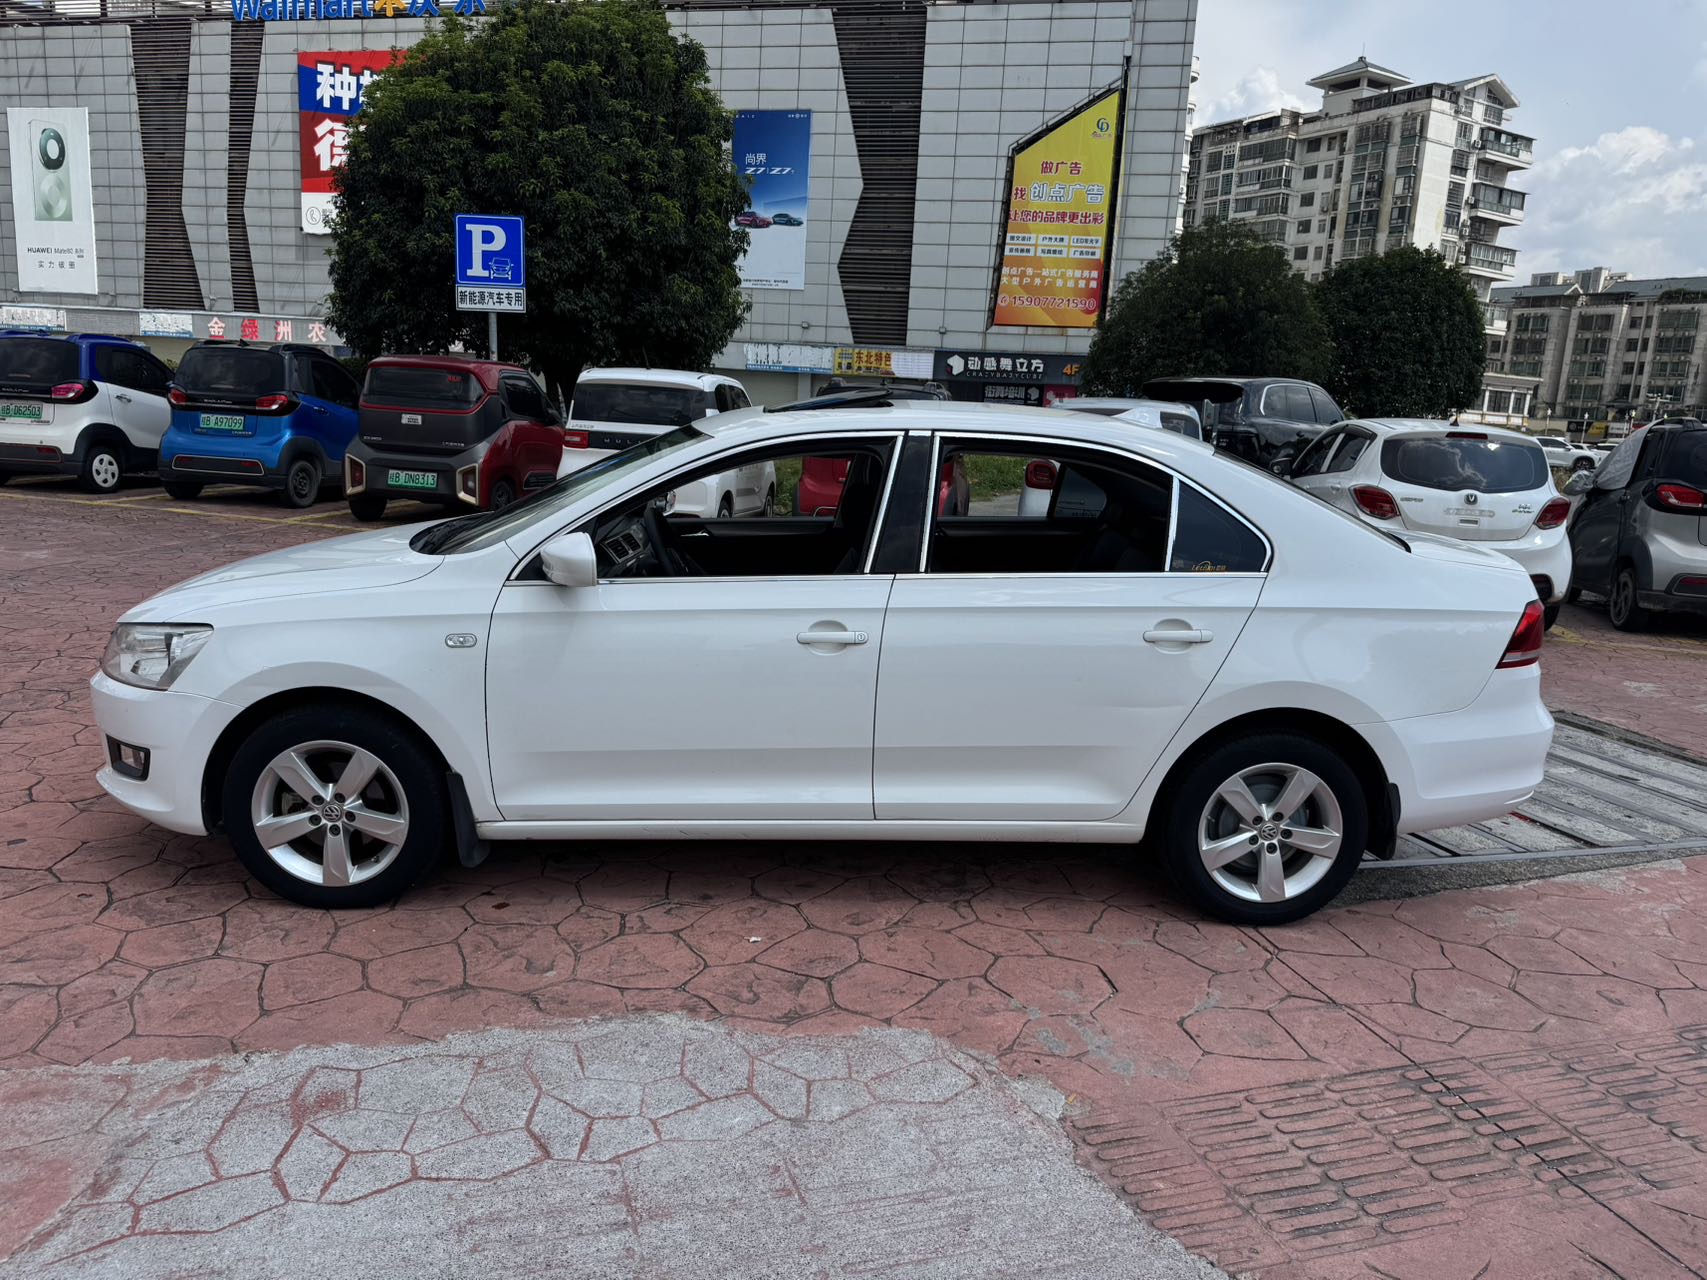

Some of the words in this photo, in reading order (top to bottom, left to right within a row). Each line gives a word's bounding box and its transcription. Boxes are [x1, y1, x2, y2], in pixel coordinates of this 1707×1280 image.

[745, 153, 767, 165] 尚界
[1040, 161, 1082, 176] 做广告
[1030, 181, 1105, 204] 创点广告
[465, 223, 507, 277] P
[458, 290, 523, 307] 新能源汽车专用
[1012, 295, 1097, 309] 15907721590
[855, 351, 892, 367] 东北特色
[967, 356, 1045, 373] 动感舞立方
